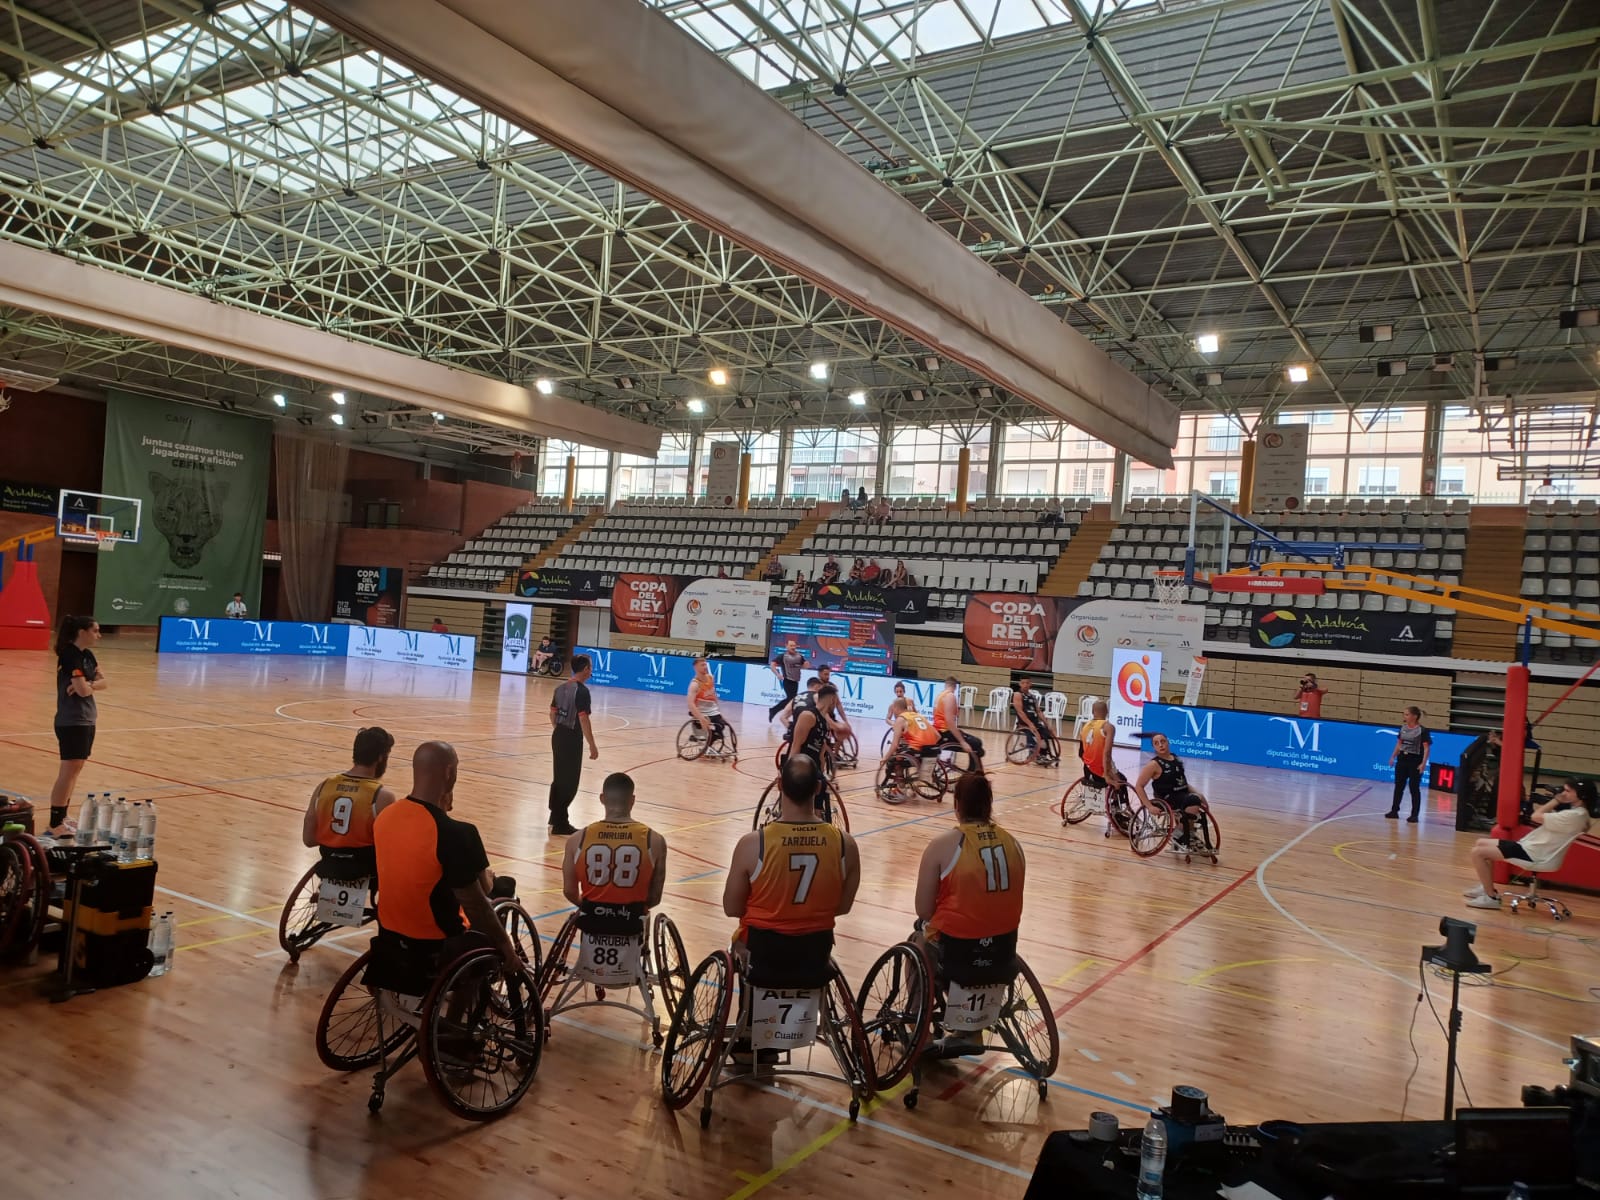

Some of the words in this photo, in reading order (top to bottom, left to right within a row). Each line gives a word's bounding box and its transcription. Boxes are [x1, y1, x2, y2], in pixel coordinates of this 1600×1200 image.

[141, 435, 173, 449] juntas
[174, 441, 214, 456] cazamos
[151, 445, 199, 461] jugadoras
[200, 454, 206, 463] y
[206, 454, 237, 467] afición
[357, 569, 379, 578] COPA
[357, 582, 377, 592] REY
[630, 580, 668, 593] COPA
[638, 591, 657, 600] DEL
[630, 599, 662, 612] REY
[990, 601, 1046, 616] COPA
[178, 618, 210, 640] M
[1003, 615, 1030, 625] DEL
[243, 620, 275, 641] M
[301, 623, 328, 644] M
[358, 626, 376, 647] M
[992, 623, 1040, 641] REY
[398, 630, 419, 651] M
[440, 634, 461, 656] M
[586, 648, 613, 672] M
[639, 653, 668, 678] M
[831, 673, 865, 701] M
[901, 679, 937, 707] M
[856, 703, 874, 711] málaga
[915, 716, 928, 731] 6
[1166, 706, 1217, 740] M
[1269, 716, 1323, 752] M
[1168, 738, 1195, 748] putación
[1196, 739, 1204, 747] de
[1204, 740, 1229, 752] málaga
[1186, 746, 1213, 757] deporte
[1266, 748, 1300, 760] diputación
[1301, 751, 1309, 760] de
[1310, 752, 1337, 764] málaga
[1290, 758, 1319, 769] deporte
[1438, 767, 1454, 788] 14
[331, 796, 353, 836] 9
[598, 831, 633, 840] ONRUBIA
[781, 836, 827, 847] ZARZUELA
[585, 844, 642, 888] 88
[979, 843, 1010, 893] 11
[789, 852, 819, 905] 7
[337, 890, 349, 906] 9
[588, 935, 631, 946] ONRUBIA
[593, 947, 618, 966] 88
[967, 993, 986, 1011] 11
[778, 1003, 793, 1025] 7
[774, 1031, 804, 1040] Cualtis
